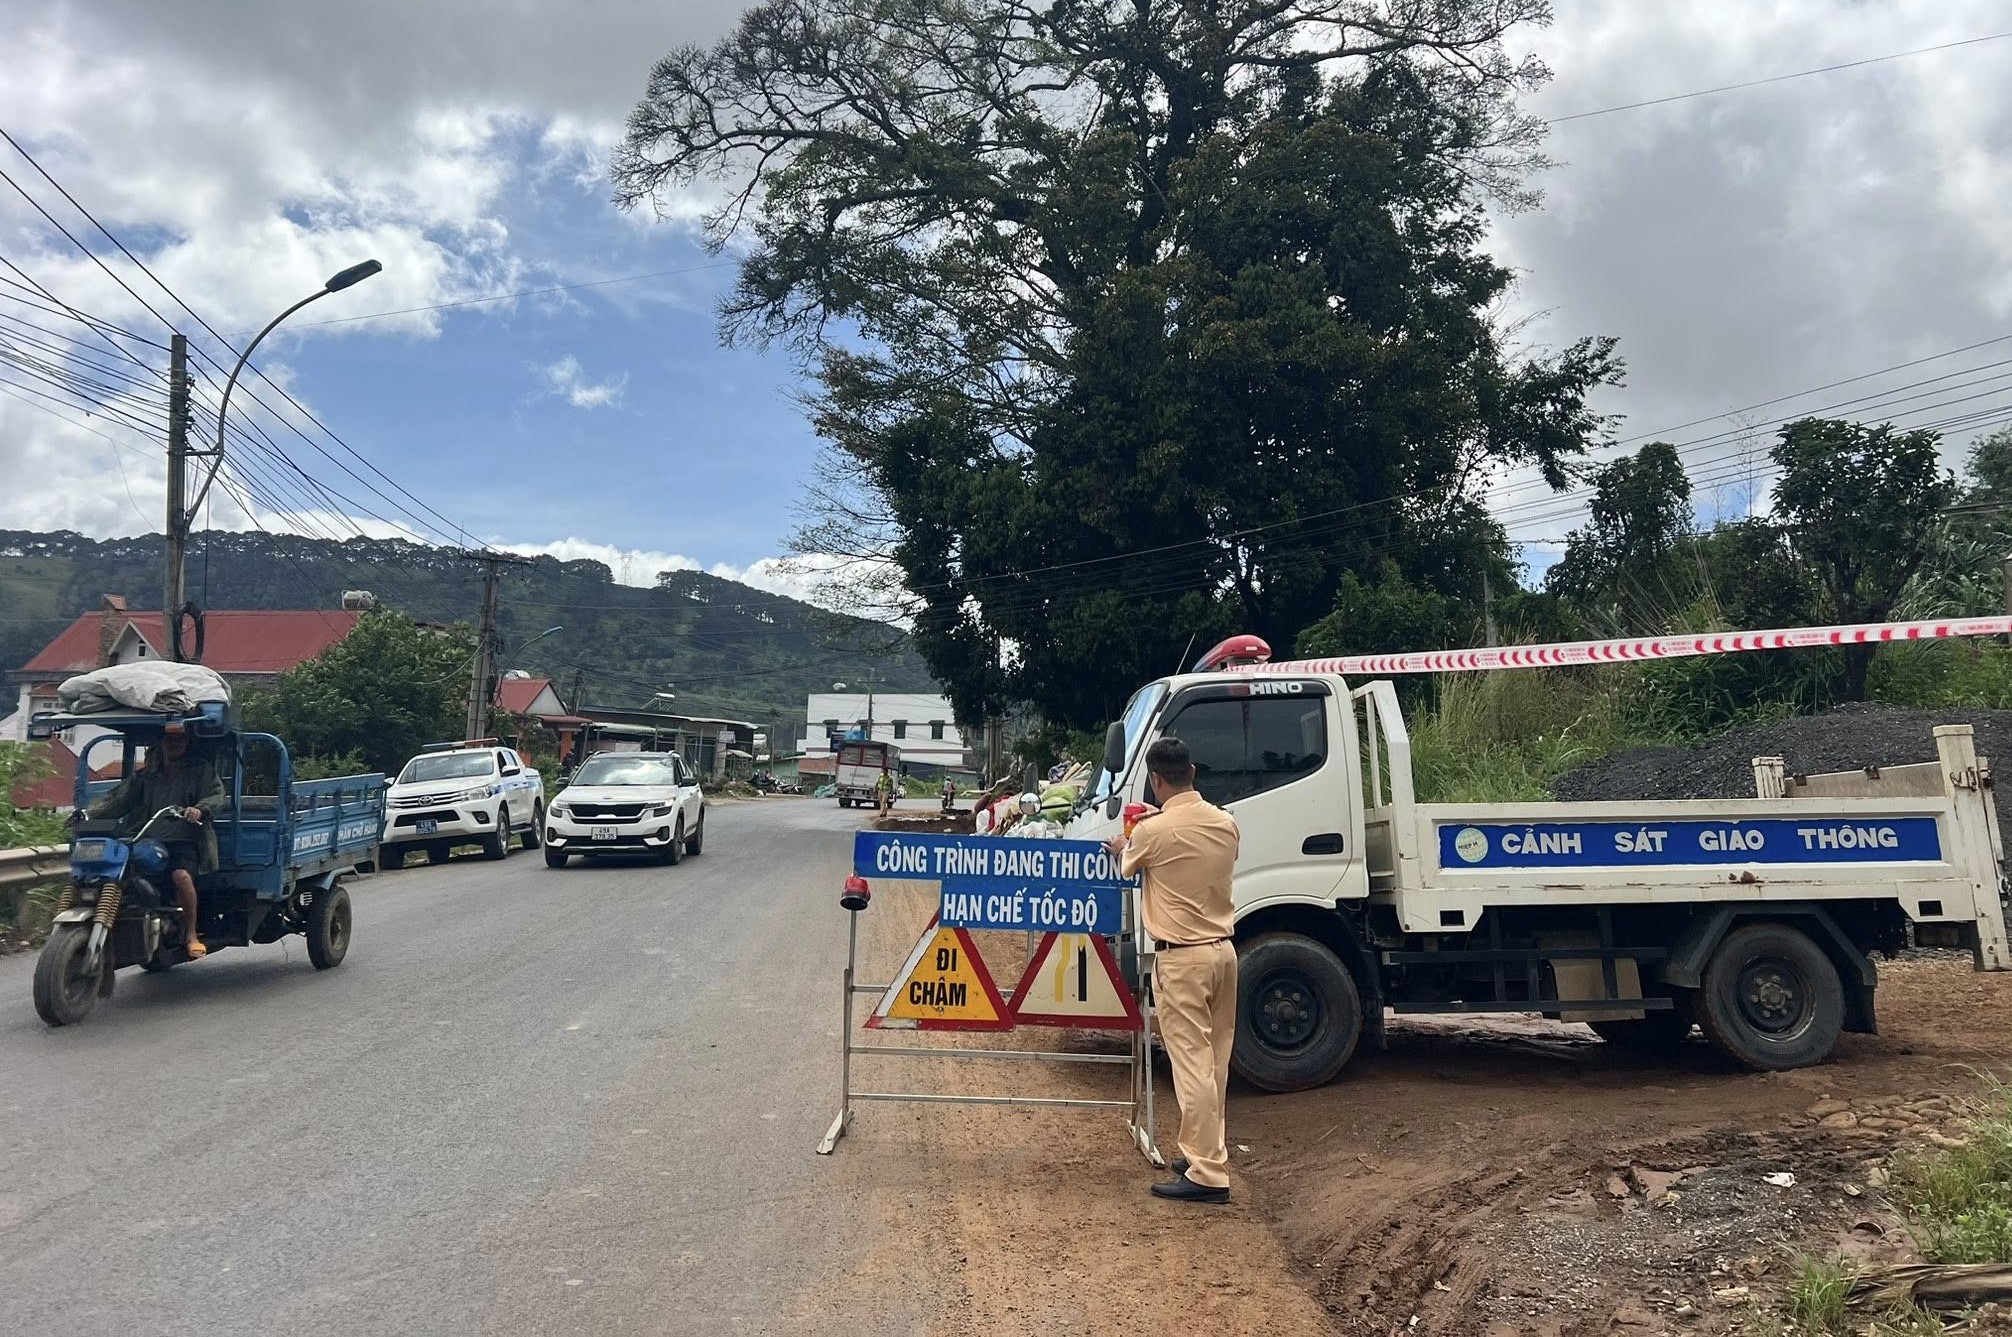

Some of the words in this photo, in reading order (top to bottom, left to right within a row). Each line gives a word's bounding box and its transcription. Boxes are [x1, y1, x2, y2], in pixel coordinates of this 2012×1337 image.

[1249, 681, 1303, 695] HINO
[1501, 828, 1582, 854] CẢNH
[1614, 827, 1668, 852] SÁT
[1698, 829, 1765, 851] GIAO
[1797, 825, 1898, 850] THÔNG
[876, 839, 927, 873] CÔNG
[934, 842, 988, 876] TRÌNH
[994, 850, 1044, 878] ĐANG
[1049, 852, 1080, 879] THI
[1083, 847, 1141, 887] CÔN,
[943, 893, 982, 927] HẠN
[986, 887, 1028, 923] CHẾ
[1029, 888, 1066, 925] TỐC
[1071, 893, 1098, 931] ĐỘ
[936, 948, 957, 972] ĐI
